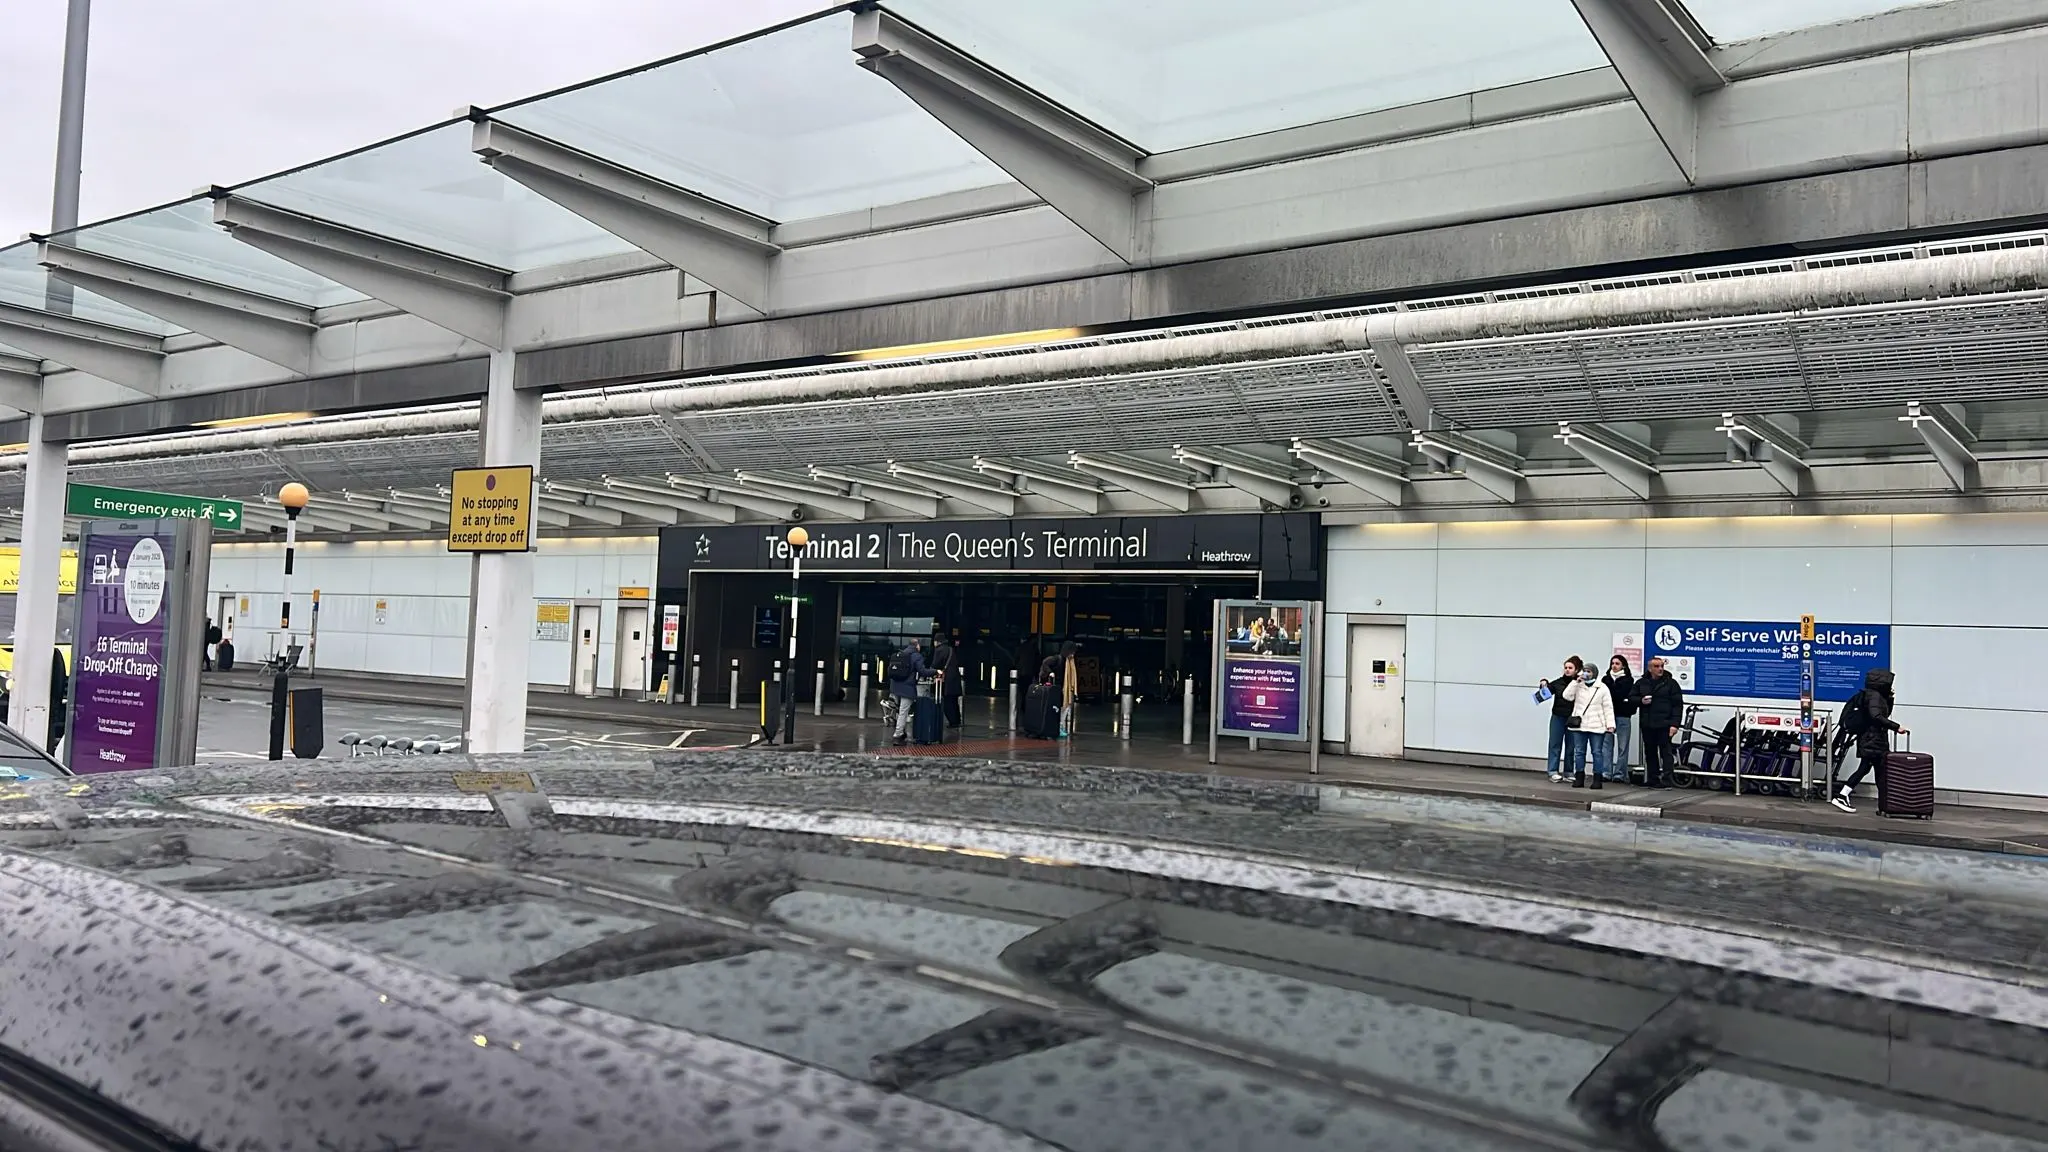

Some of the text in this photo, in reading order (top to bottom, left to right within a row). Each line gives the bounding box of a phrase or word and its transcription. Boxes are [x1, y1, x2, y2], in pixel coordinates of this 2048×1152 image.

[94, 497, 197, 518] Emergency exit
[461, 496, 519, 510] No stopping
[462, 513, 515, 528] at any time
[452, 530, 525, 545] except drop off
[898, 527, 1147, 562] The Queen's Terminal
[867, 534, 880, 559] 2
[1201, 550, 1252, 562] Heathrow
[130, 580, 160, 590] 10 minutes
[1685, 627, 1878, 646] Self Serve Whelchair
[97, 636, 148, 655] £6 Terminal
[1814, 649, 1878, 658] dependent journey
[83, 655, 158, 681] Drop-Off Charge
[1233, 666, 1254, 674] Enhance
[99, 748, 127, 763] Heathrow
